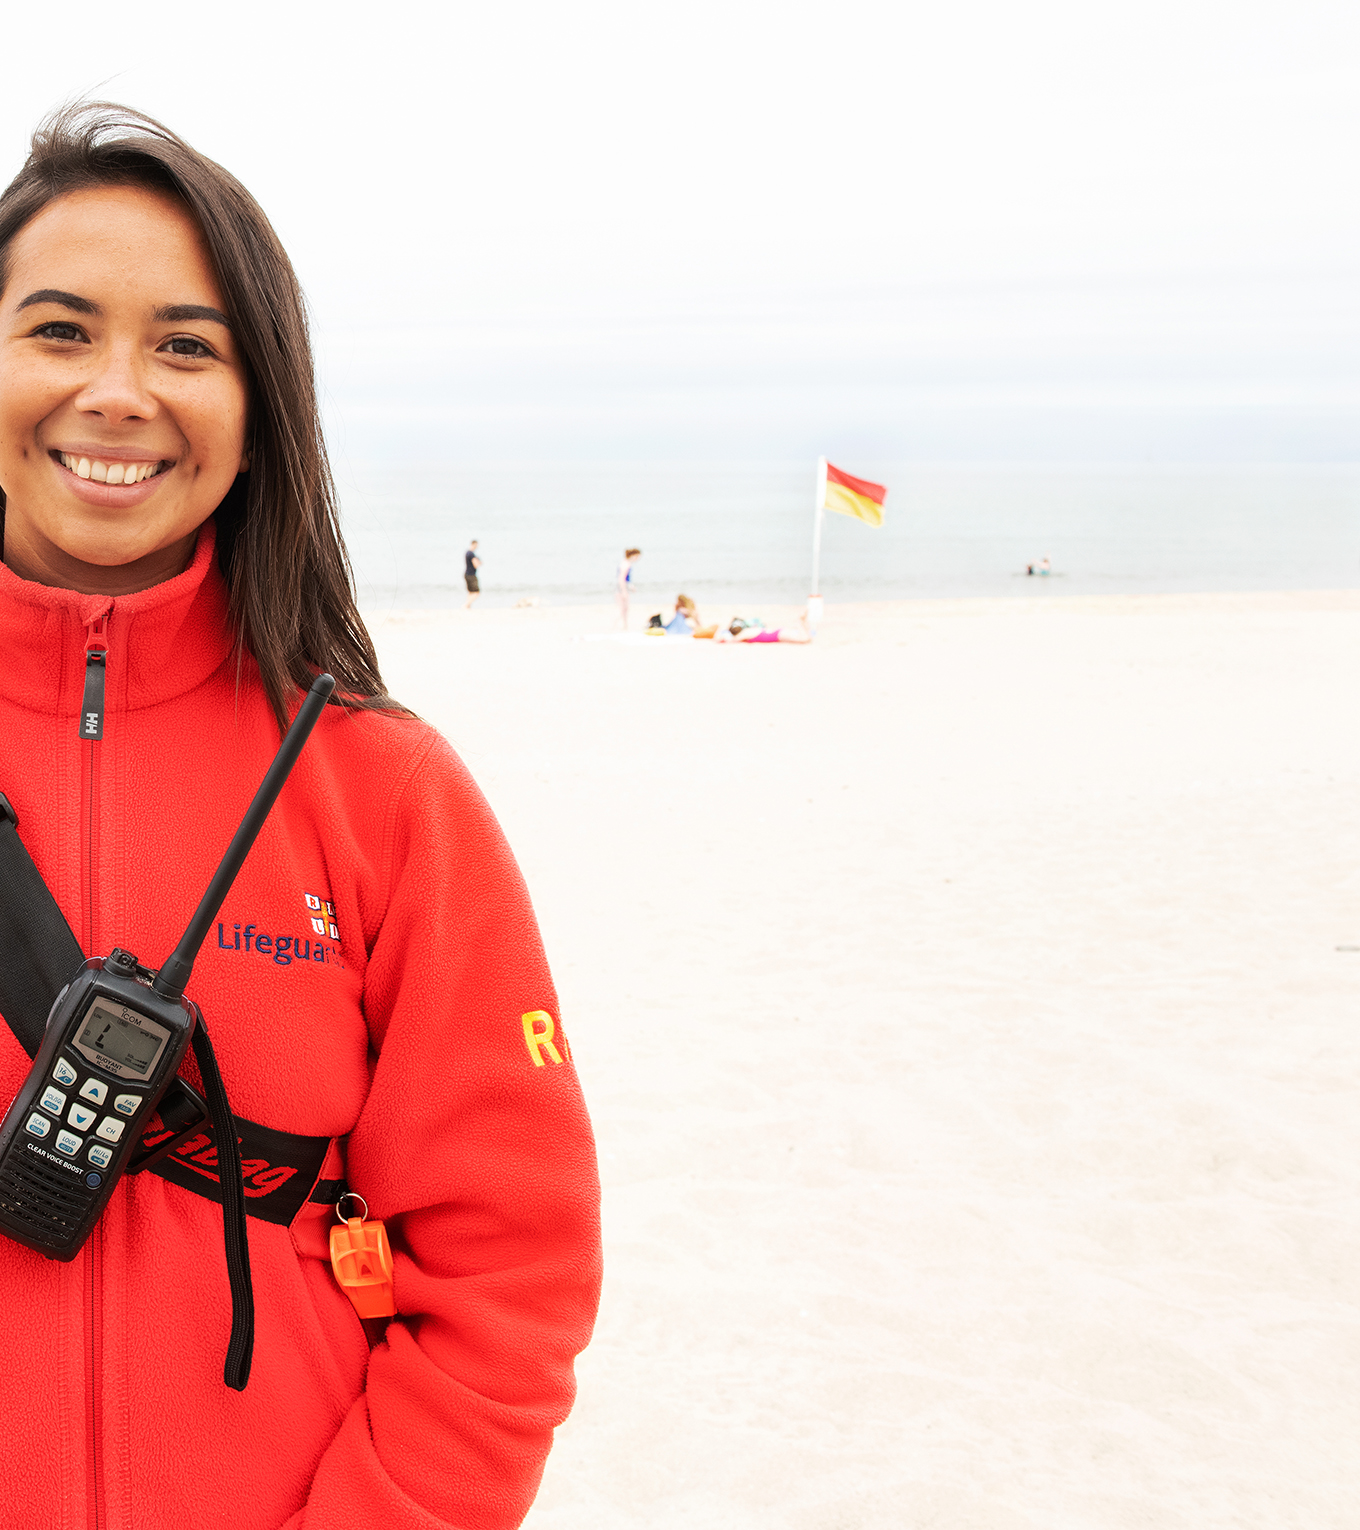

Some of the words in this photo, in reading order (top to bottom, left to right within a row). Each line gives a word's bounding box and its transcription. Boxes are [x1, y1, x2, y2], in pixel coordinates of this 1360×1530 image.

[521, 1009, 570, 1067] R
[96, 1054, 123, 1071] BUOYANT
[59, 1067, 67, 1075] 16
[124, 1099, 137, 1108] FAV
[32, 1117, 46, 1128] SCAN
[105, 1126, 116, 1135] CH
[61, 1136, 77, 1147] LOUD
[27, 1143, 46, 1157] CLEAR
[46, 1152, 64, 1166] VOICE
[62, 1161, 84, 1175] BOOST
